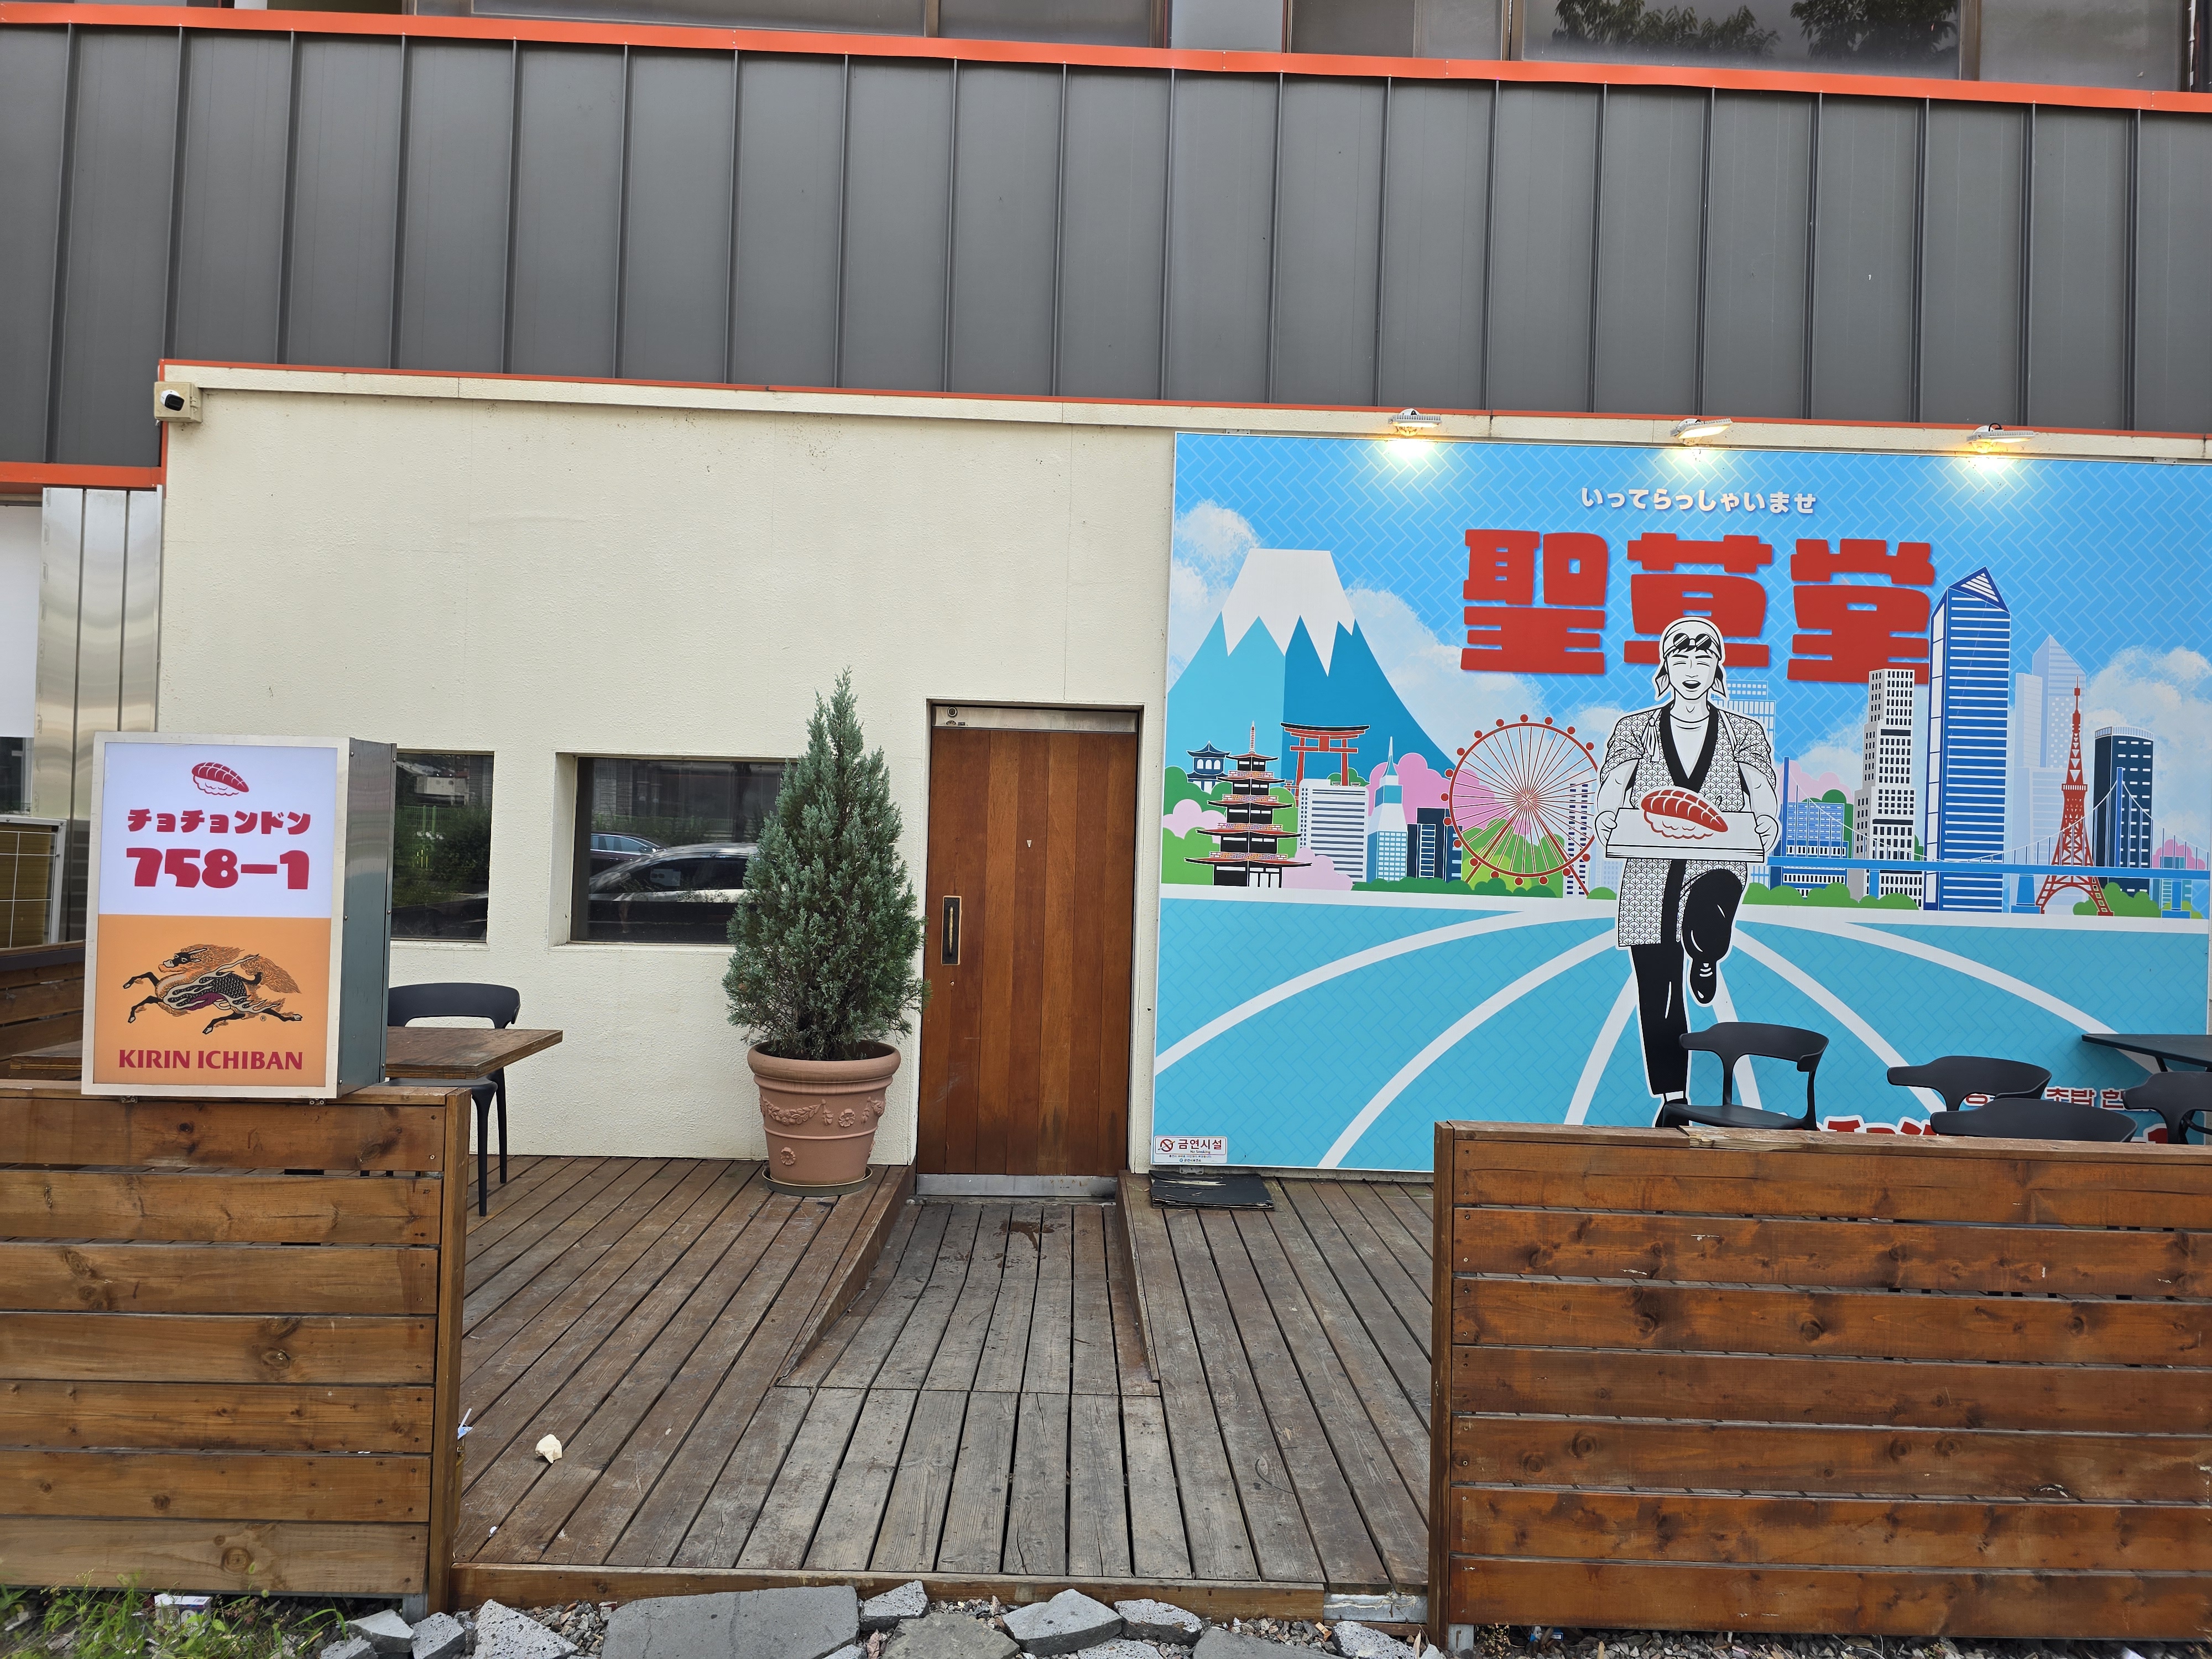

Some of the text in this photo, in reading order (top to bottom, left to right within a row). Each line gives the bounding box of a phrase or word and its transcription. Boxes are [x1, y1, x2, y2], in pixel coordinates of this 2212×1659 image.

[1581, 487, 1816, 514] いってらっしゃいませ
[1460, 528, 1936, 685] 聖草堂
[127, 808, 311, 835] チョチョンドン
[119, 1049, 303, 1070] KIRIN ICHIBAN
[1178, 1139, 1222, 1150] 금연시설
